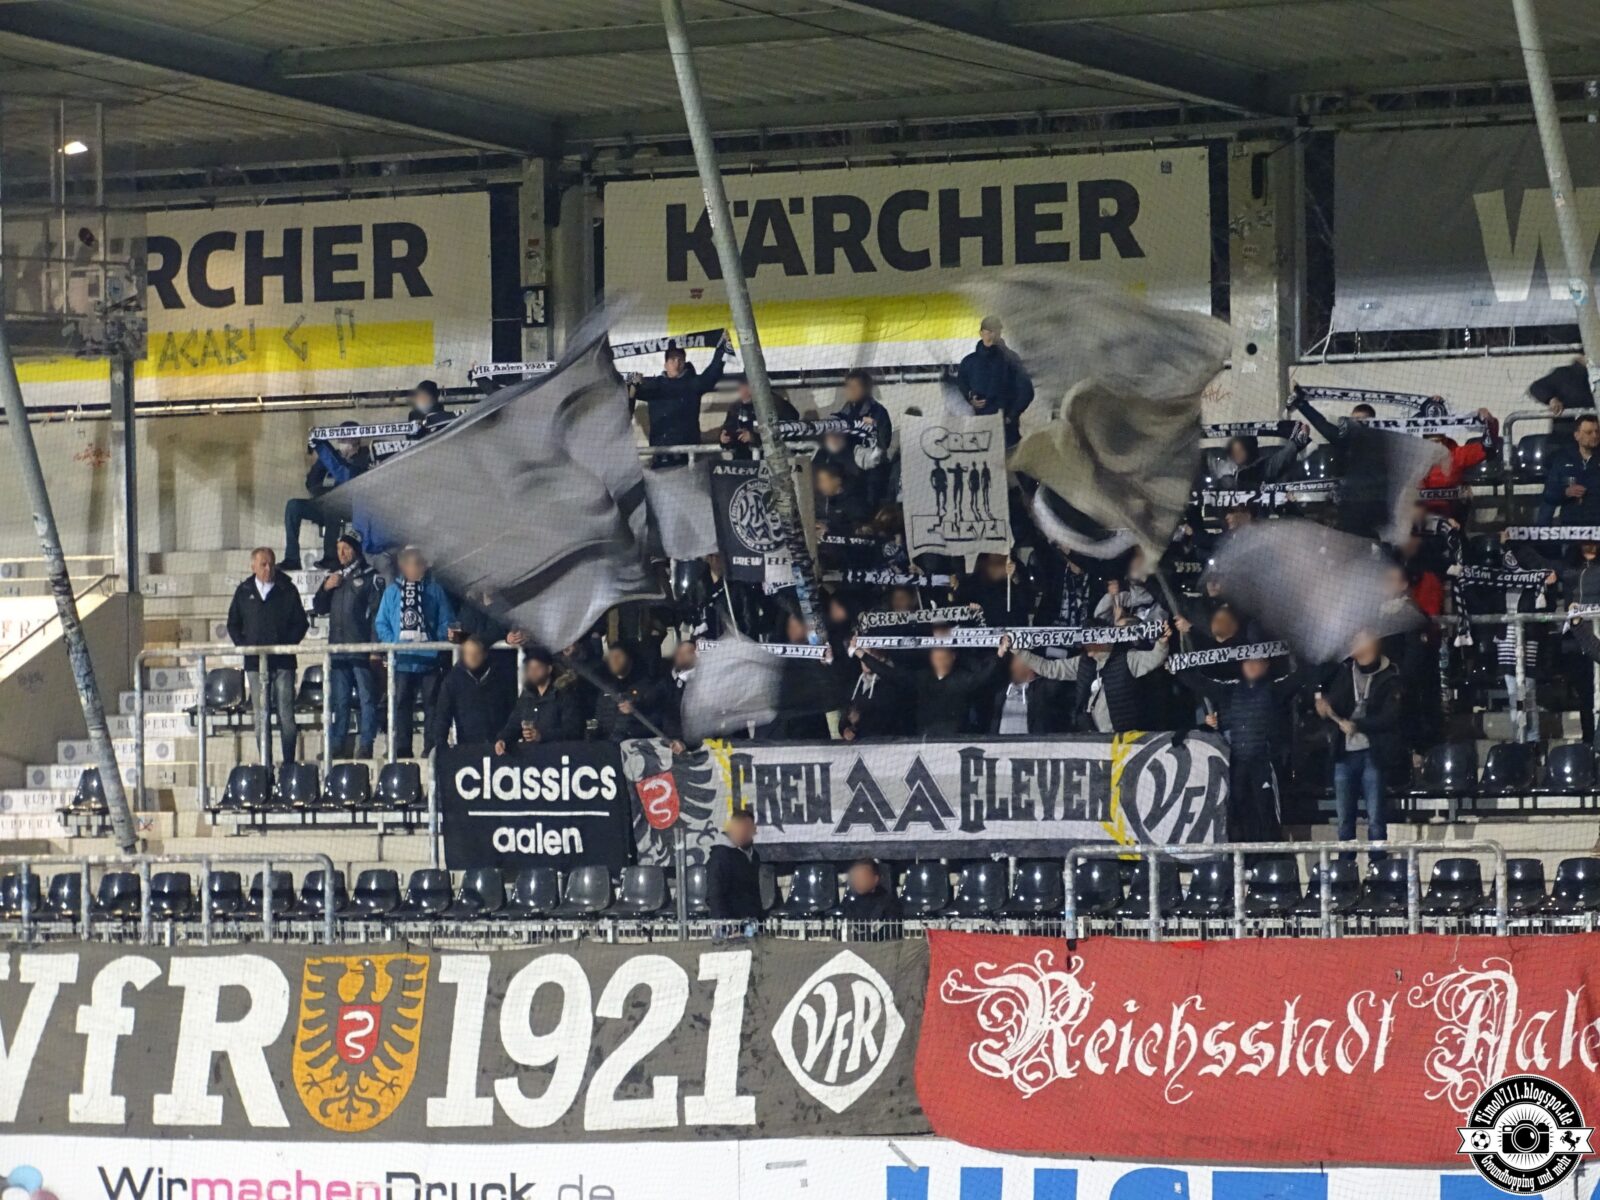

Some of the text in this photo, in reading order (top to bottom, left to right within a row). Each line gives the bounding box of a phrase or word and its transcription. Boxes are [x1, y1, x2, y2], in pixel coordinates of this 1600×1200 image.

[665, 178, 1146, 282] KÄRCHER
[328, 426, 358, 438] STADT
[377, 422, 414, 434] VEREIN
[867, 608, 971, 627] CREW ELEVEN
[856, 637, 898, 648] ULTRAS
[920, 637, 953, 647] CREW
[1031, 631, 1075, 647] CREW
[1082, 628, 1140, 644] ELEVEN
[1188, 648, 1231, 665] CREW
[116, 719, 178, 730] RUPERT
[455, 755, 617, 801] classics
[729, 752, 834, 832] CREW
[958, 747, 1113, 833] ELEVEN
[492, 822, 584, 855] aalen
[940, 949, 1399, 1105] Reichsstadt
[0, 952, 756, 1131] VfR 1921
